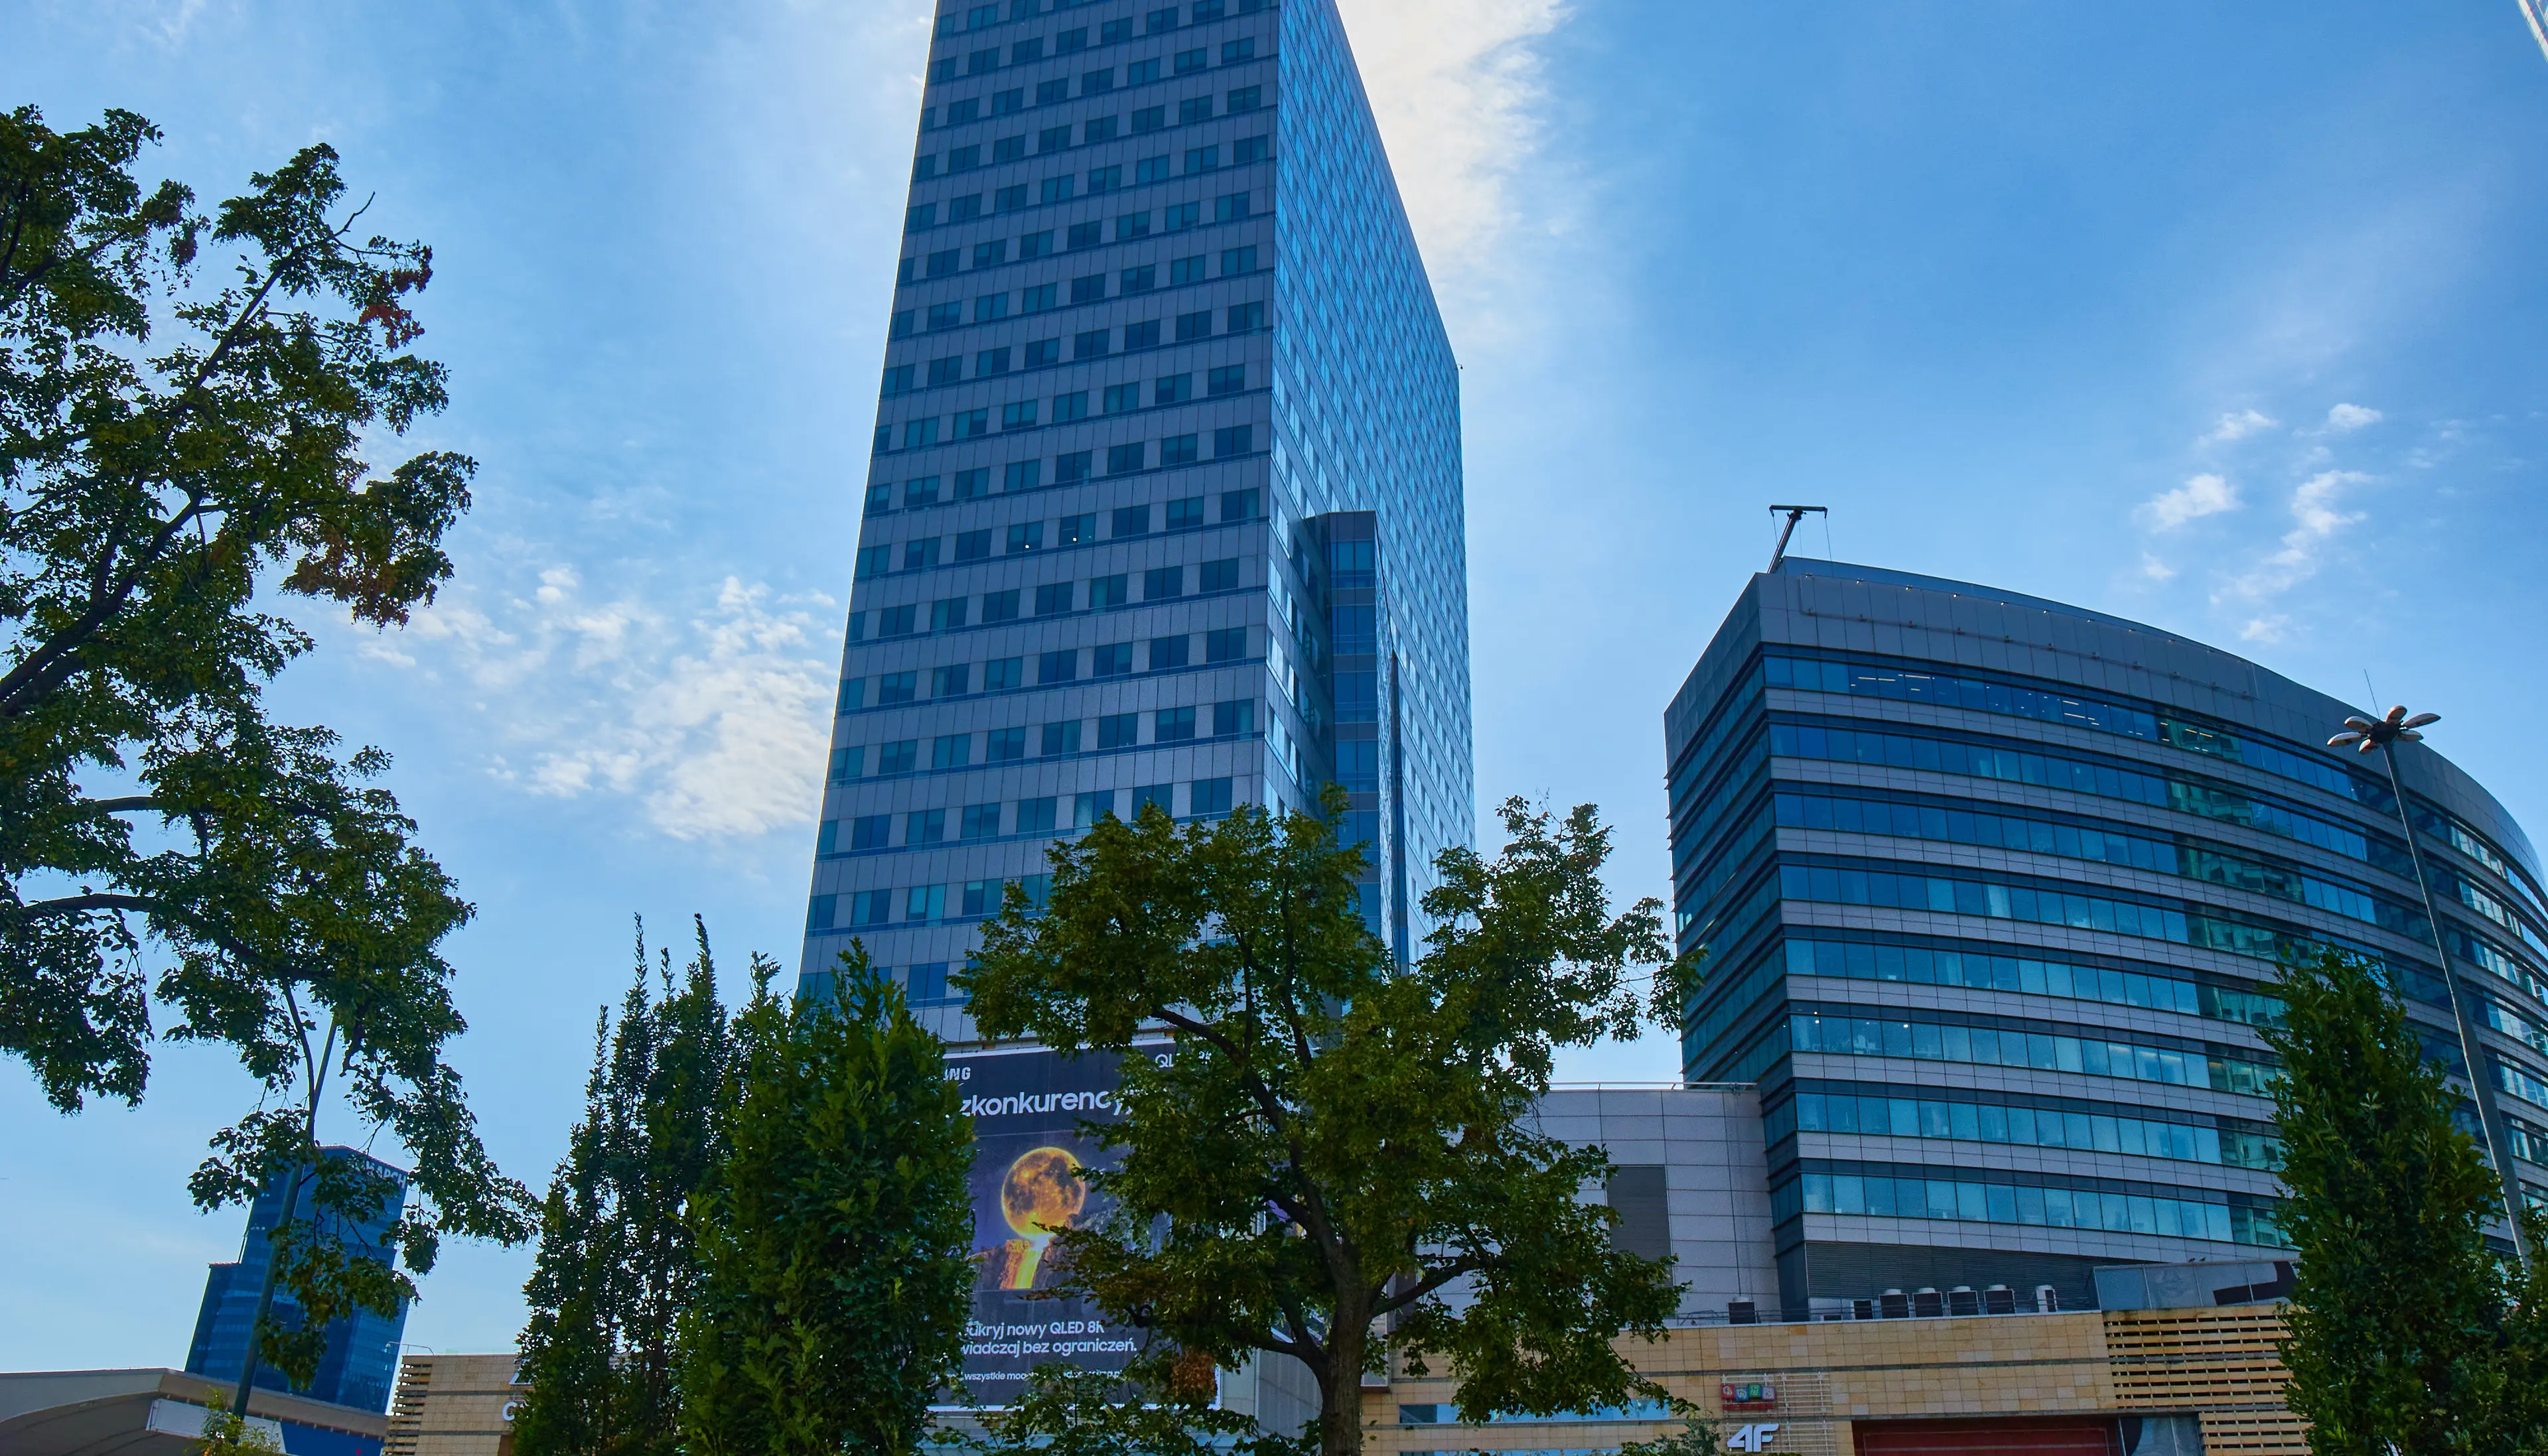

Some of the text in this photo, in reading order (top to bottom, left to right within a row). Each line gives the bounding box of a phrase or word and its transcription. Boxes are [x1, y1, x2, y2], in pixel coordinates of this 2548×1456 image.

[1155, 1053, 1180, 1069] QL
[1007, 1323, 1047, 1339] nowy
[1050, 1321, 1085, 1335] QLED
[1023, 1341, 1050, 1354] bez
[1052, 1337, 1137, 1357] ograniczeń.
[963, 1371, 1005, 1382] wszystkie
[1727, 1423, 1779, 1453] 4F
